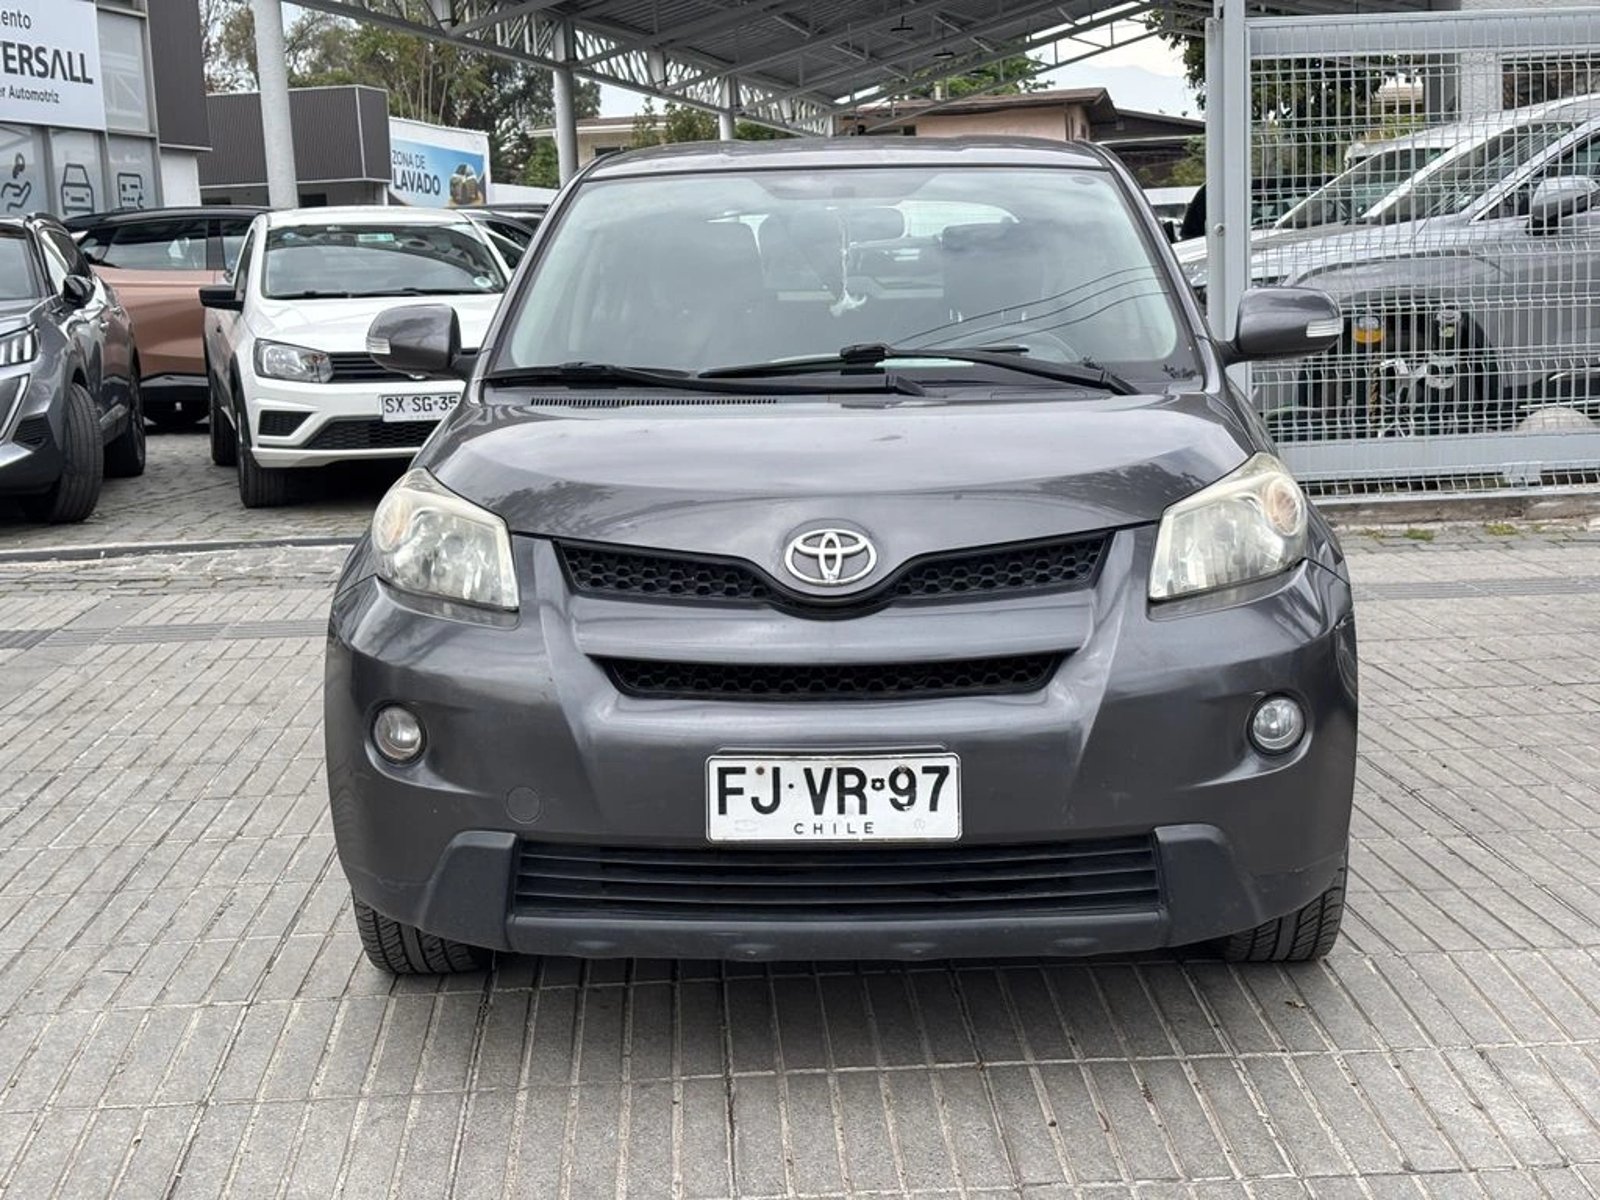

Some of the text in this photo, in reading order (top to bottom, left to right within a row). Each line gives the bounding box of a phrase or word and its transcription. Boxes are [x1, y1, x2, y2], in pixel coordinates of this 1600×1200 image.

[0, 9, 31, 29] ento
[9, 84, 60, 103] Automotriz
[392, 150, 426, 169] ZONA DE
[393, 168, 441, 195] LAVADO
[793, 822, 874, 835] CHILE
